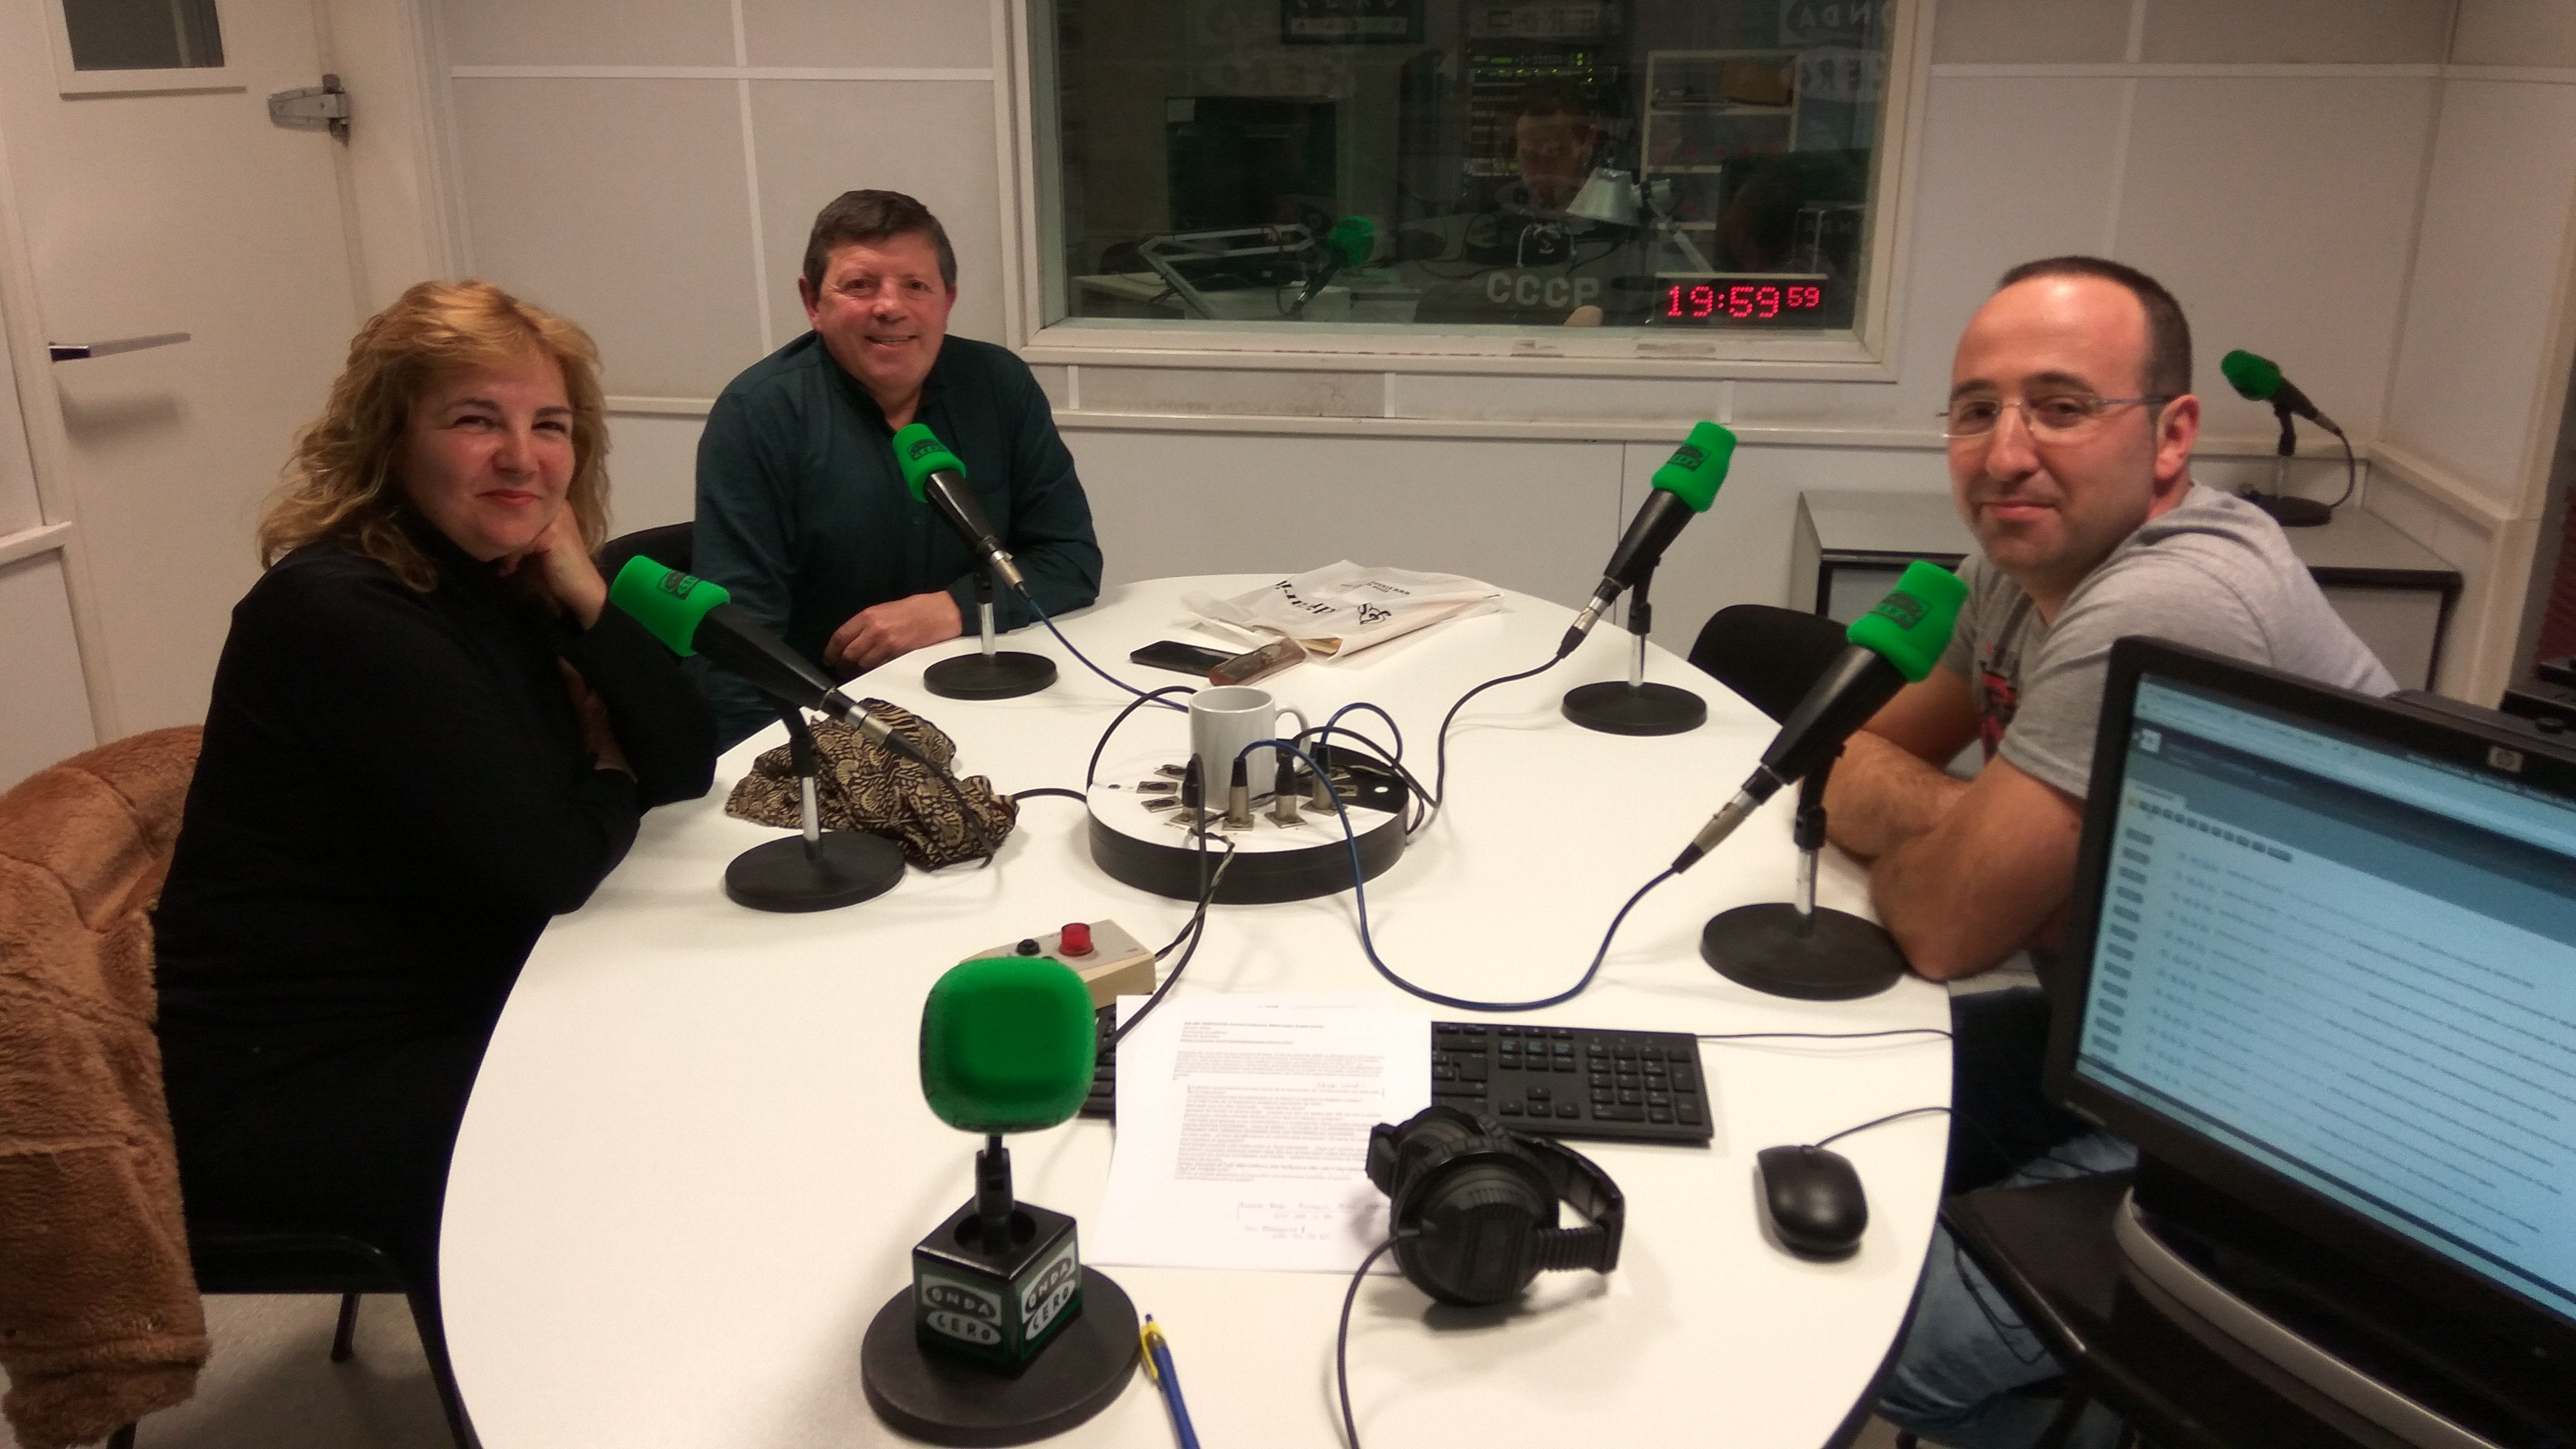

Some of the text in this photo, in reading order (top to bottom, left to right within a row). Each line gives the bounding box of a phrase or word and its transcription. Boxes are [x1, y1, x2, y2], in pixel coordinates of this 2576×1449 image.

[1486, 271, 1600, 309] CCCP
[1667, 285, 1820, 318] 19:59 59
[931, 1287, 989, 1316] ONDA
[1029, 1262, 1068, 1308] ONDA
[1033, 1286, 1069, 1330] CERO
[937, 1314, 991, 1339] CERO
